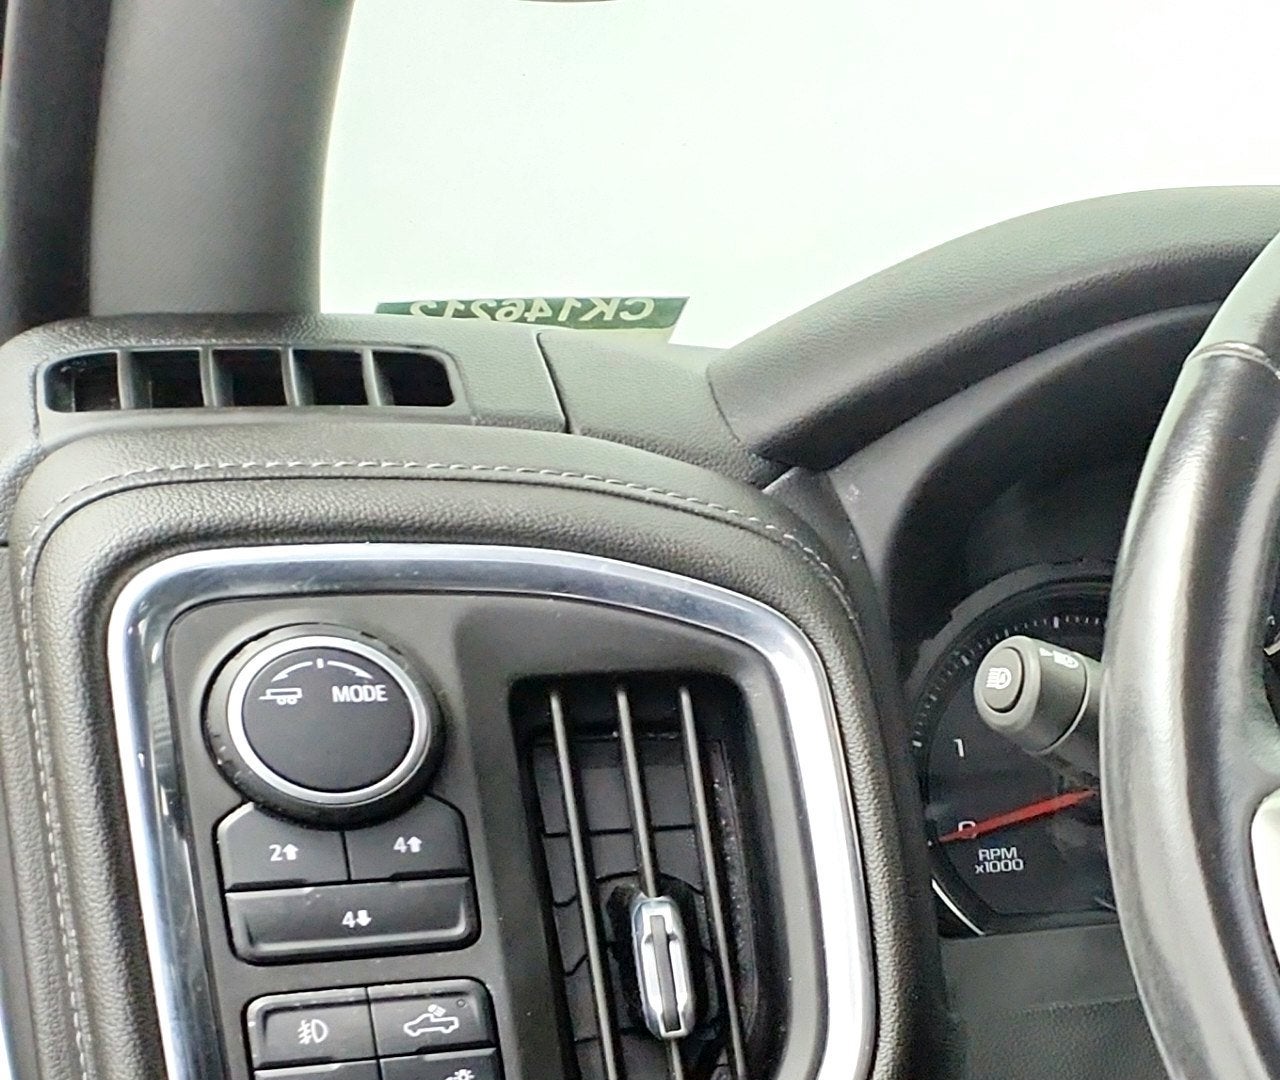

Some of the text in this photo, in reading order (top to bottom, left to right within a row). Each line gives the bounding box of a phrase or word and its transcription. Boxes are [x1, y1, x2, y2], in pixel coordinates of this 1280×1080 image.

[331, 684, 389, 703] MODE
[953, 737, 965, 758] 1
[978, 846, 1018, 862] RPM
[974, 858, 1025, 875] x1000
